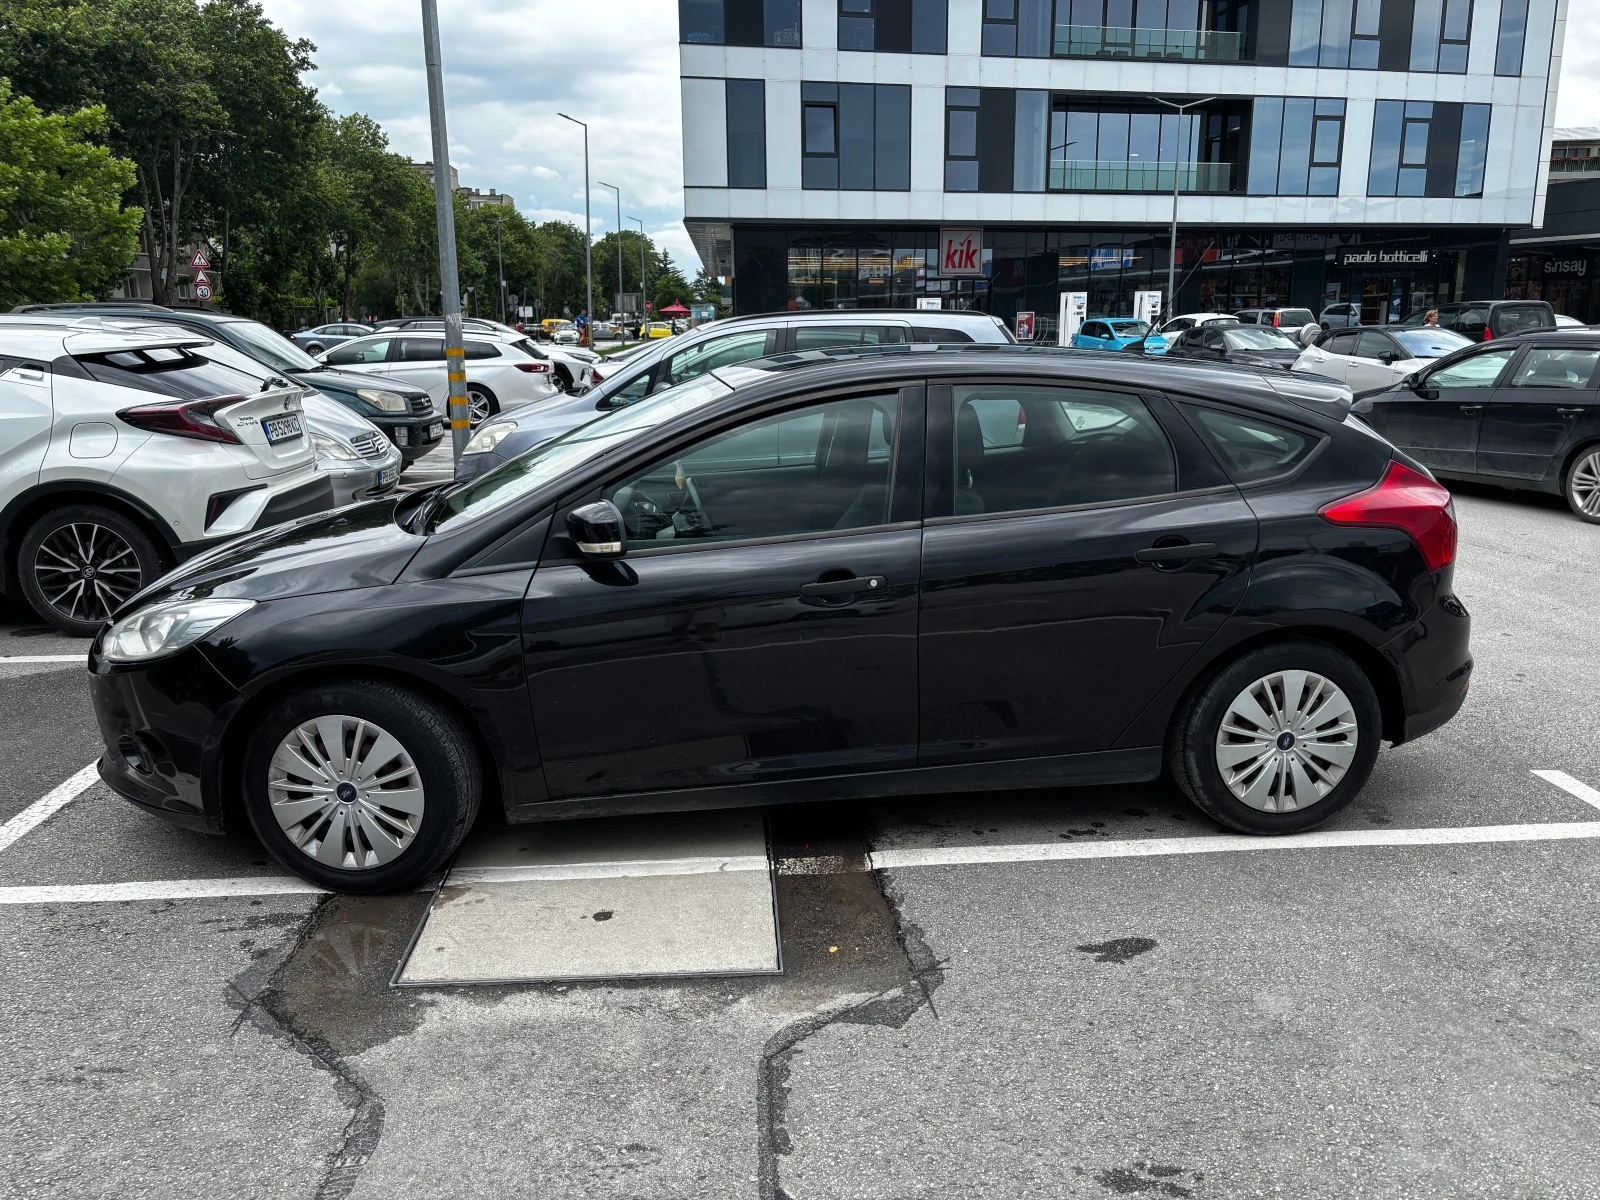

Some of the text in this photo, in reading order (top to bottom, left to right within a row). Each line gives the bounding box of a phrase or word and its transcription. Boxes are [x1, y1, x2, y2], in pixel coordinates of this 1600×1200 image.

[945, 236, 978, 268] kik
[1344, 250, 1429, 266] paolo botticelli
[1543, 257, 1587, 277] sinsay
[199, 287, 209, 297] 30
